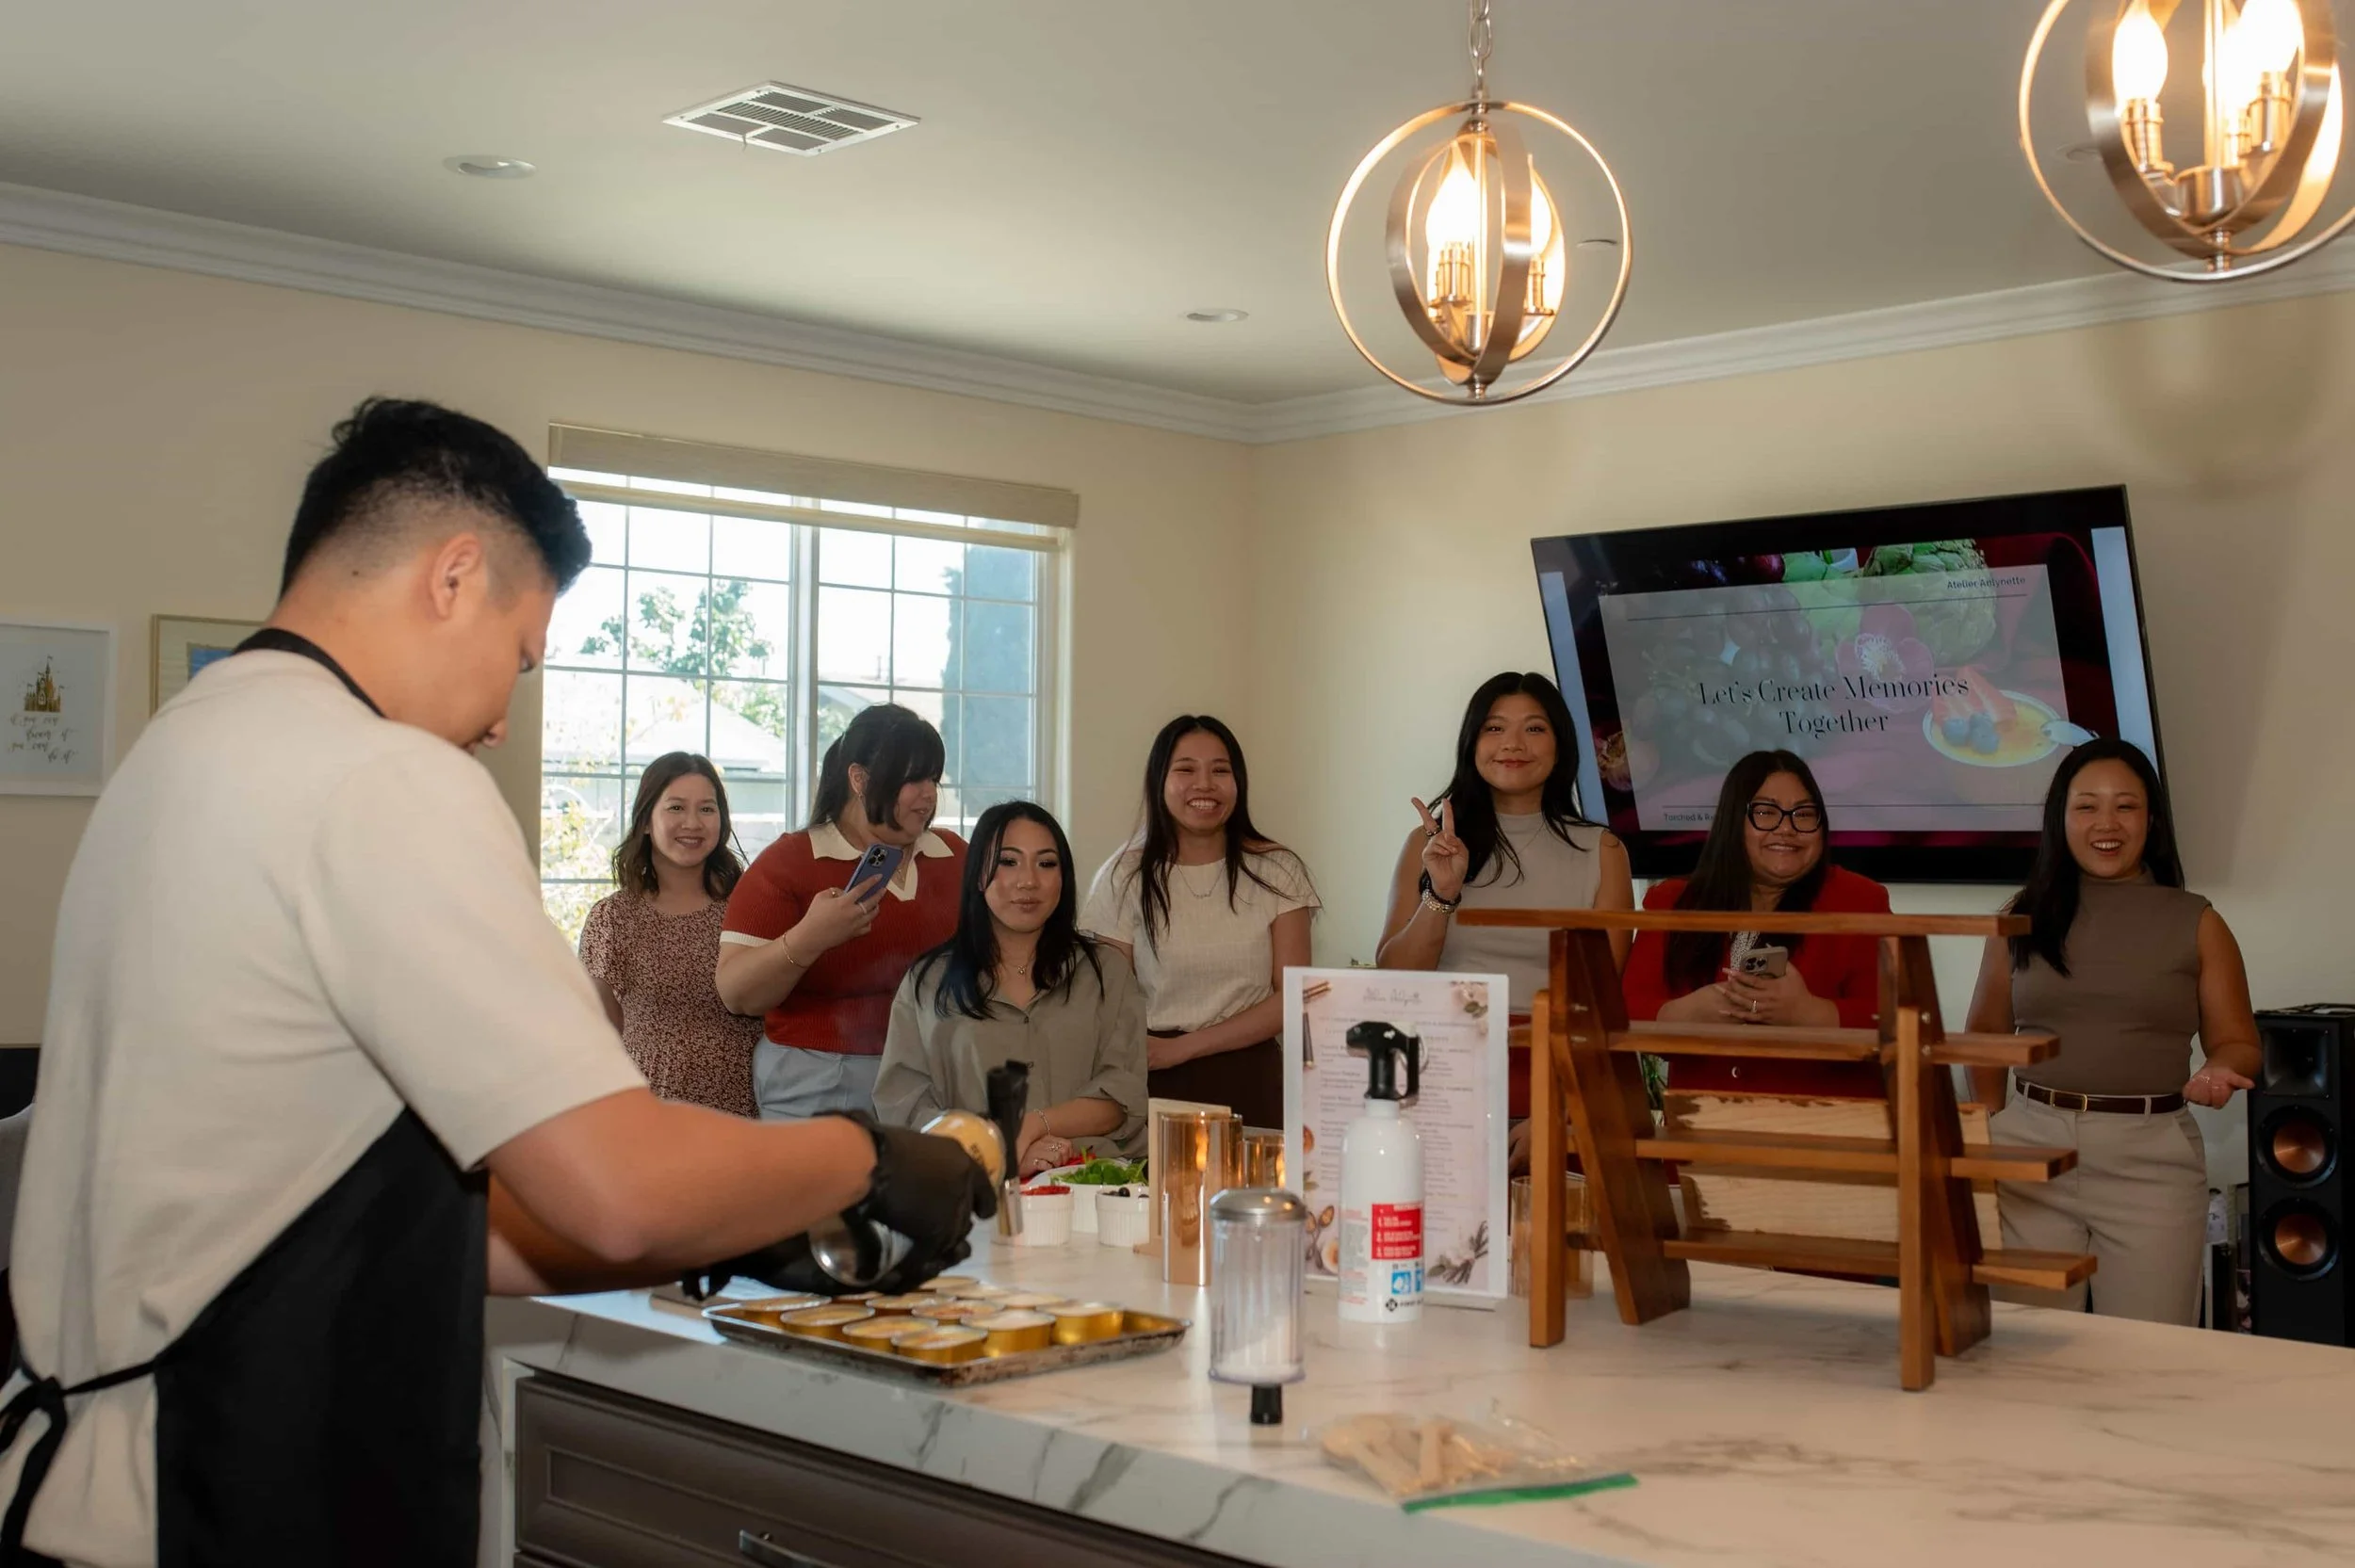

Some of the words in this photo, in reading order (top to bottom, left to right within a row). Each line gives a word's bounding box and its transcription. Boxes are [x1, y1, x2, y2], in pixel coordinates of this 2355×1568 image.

[1699, 681, 1752, 704] Let's
[1758, 679, 1837, 703] Create
[1843, 674, 1970, 700] Memories
[1779, 709, 1889, 739] Together
